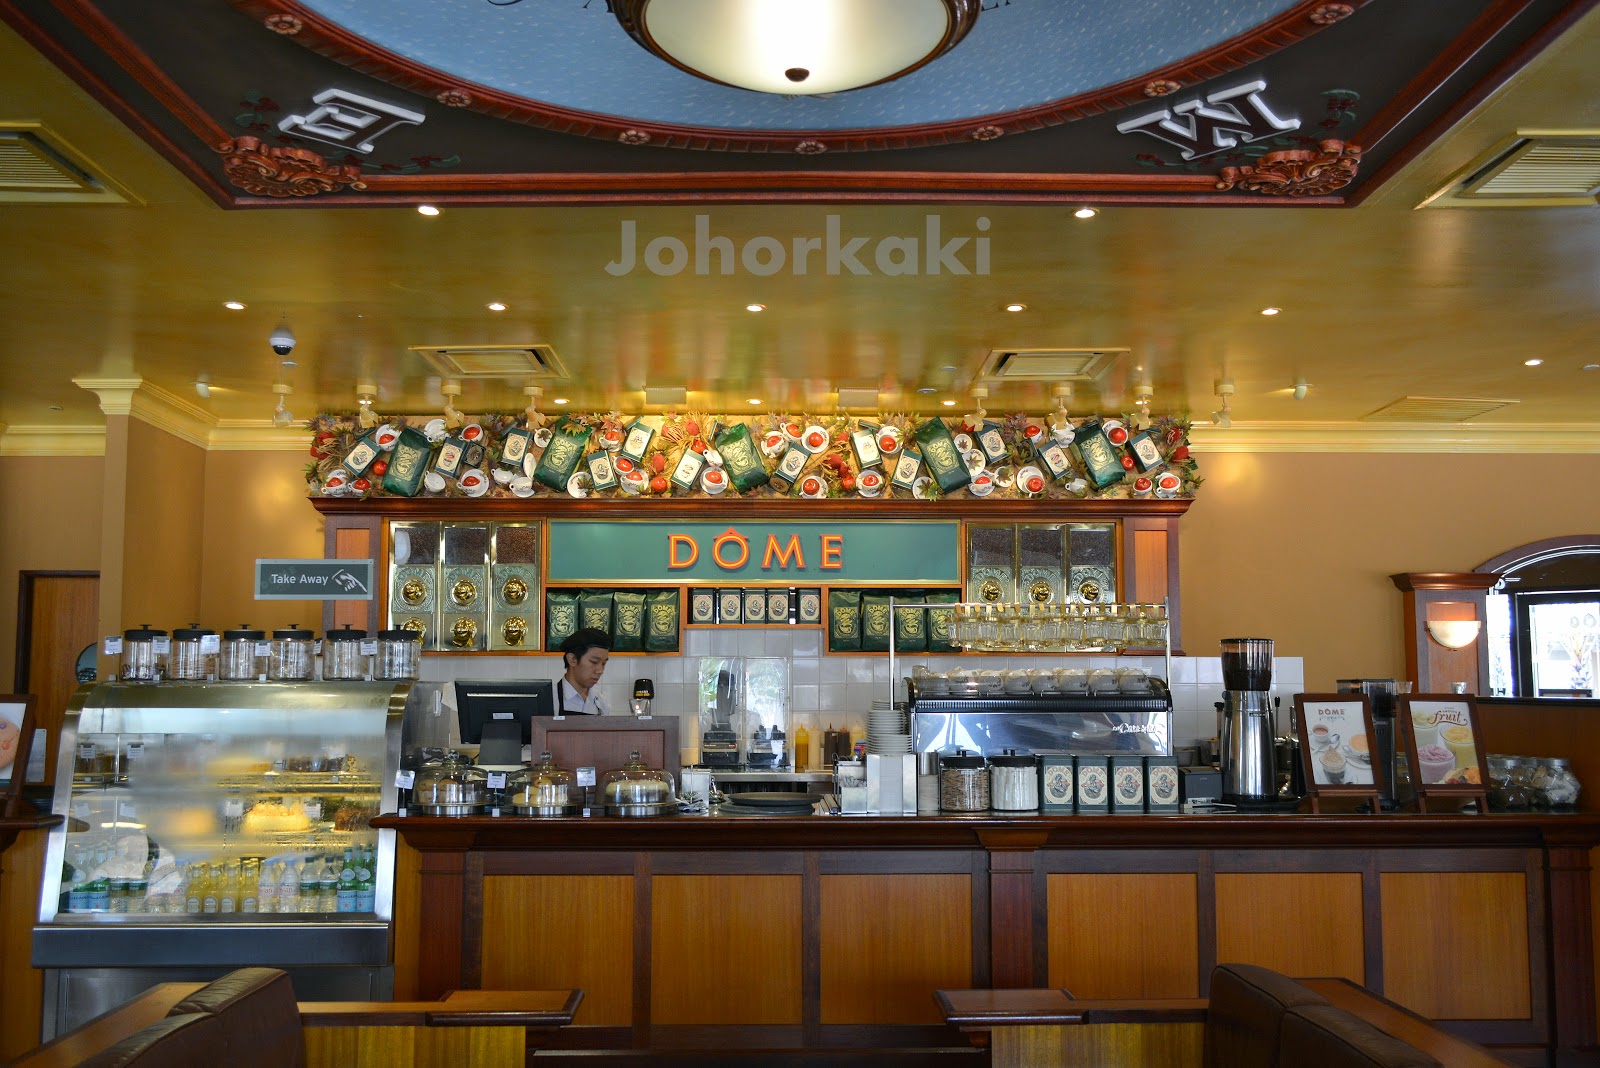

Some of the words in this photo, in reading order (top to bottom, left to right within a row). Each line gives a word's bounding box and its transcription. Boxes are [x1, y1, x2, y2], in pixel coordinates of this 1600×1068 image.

[271, 574, 296, 584] Take
[299, 574, 329, 586] Away
[1427, 710, 1468, 726] fruit
